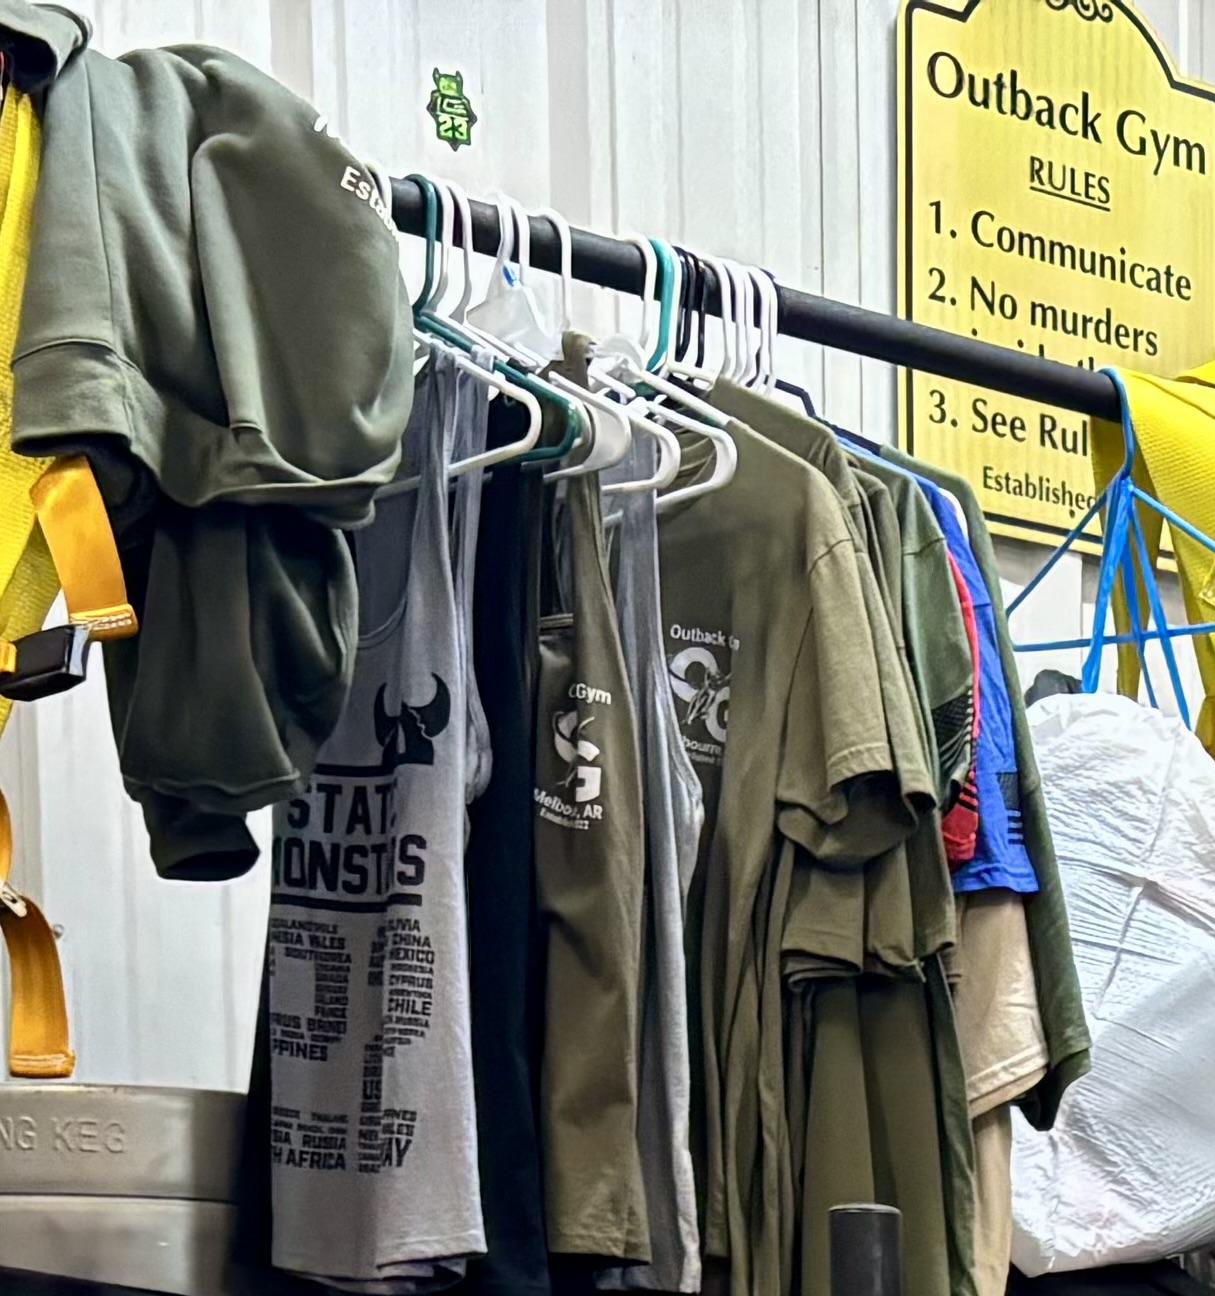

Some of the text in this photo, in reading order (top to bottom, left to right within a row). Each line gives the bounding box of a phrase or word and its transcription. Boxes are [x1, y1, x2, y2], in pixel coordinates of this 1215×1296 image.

[927, 51, 1206, 176] Outback Gym
[1029, 156, 1111, 205] RULES
[929, 200, 1192, 300] 1. Communicate
[928, 268, 957, 307] 2.
[970, 276, 1017, 320] No
[1030, 301, 1158, 357] murders
[928, 390, 1088, 457] 3. See Rul
[670, 624, 726, 647] Outback
[576, 682, 612, 706] Gym
[287, 783, 398, 836] STAT
[583, 803, 603, 820] AR
[387, 998, 433, 1016] CHILE
[51, 1116, 126, 1155] KEG
